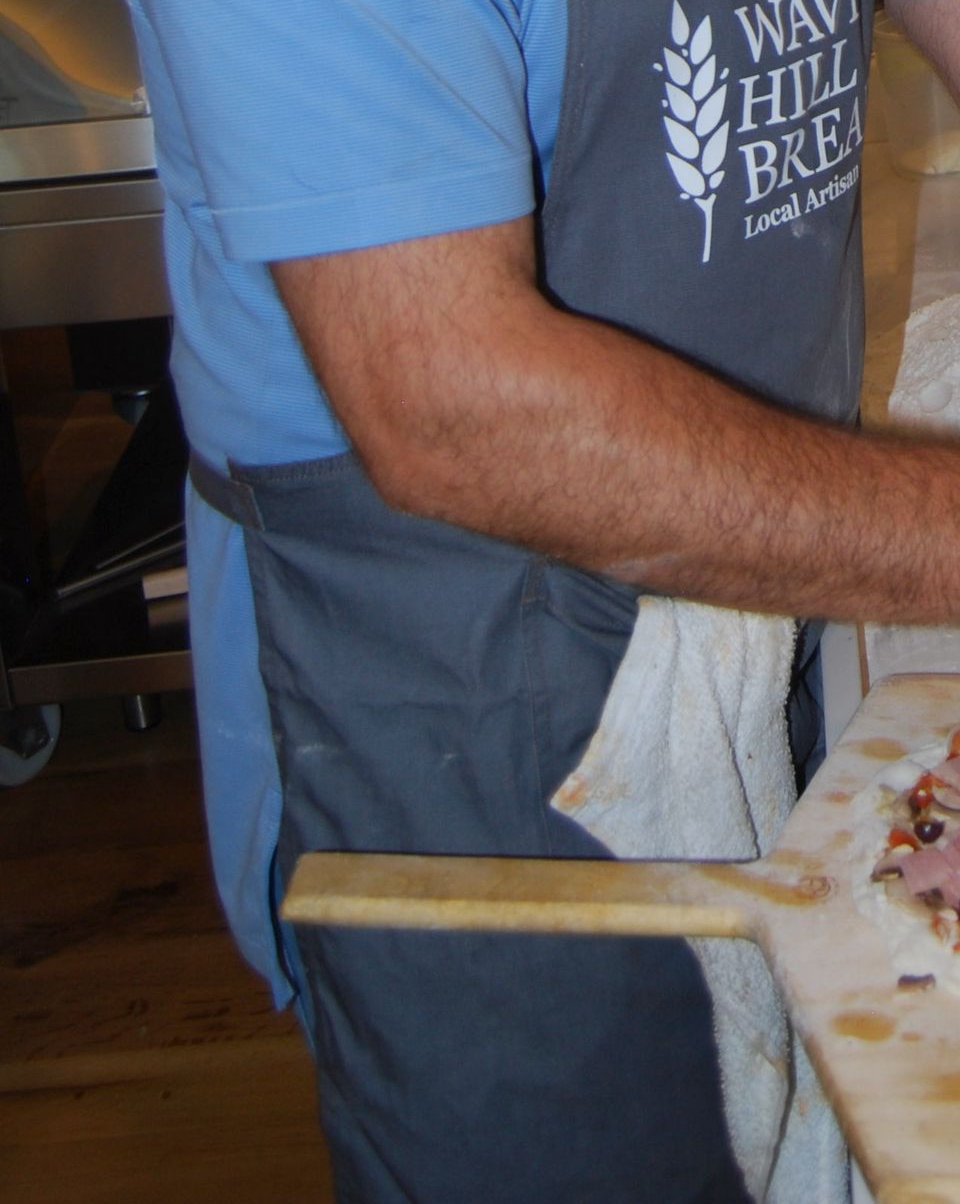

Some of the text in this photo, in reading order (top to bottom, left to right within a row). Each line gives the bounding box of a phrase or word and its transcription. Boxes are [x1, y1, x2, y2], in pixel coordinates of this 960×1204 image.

[737, 39, 857, 133] HILL
[738, 97, 863, 204] BREA
[745, 164, 859, 239] Local Artisan
